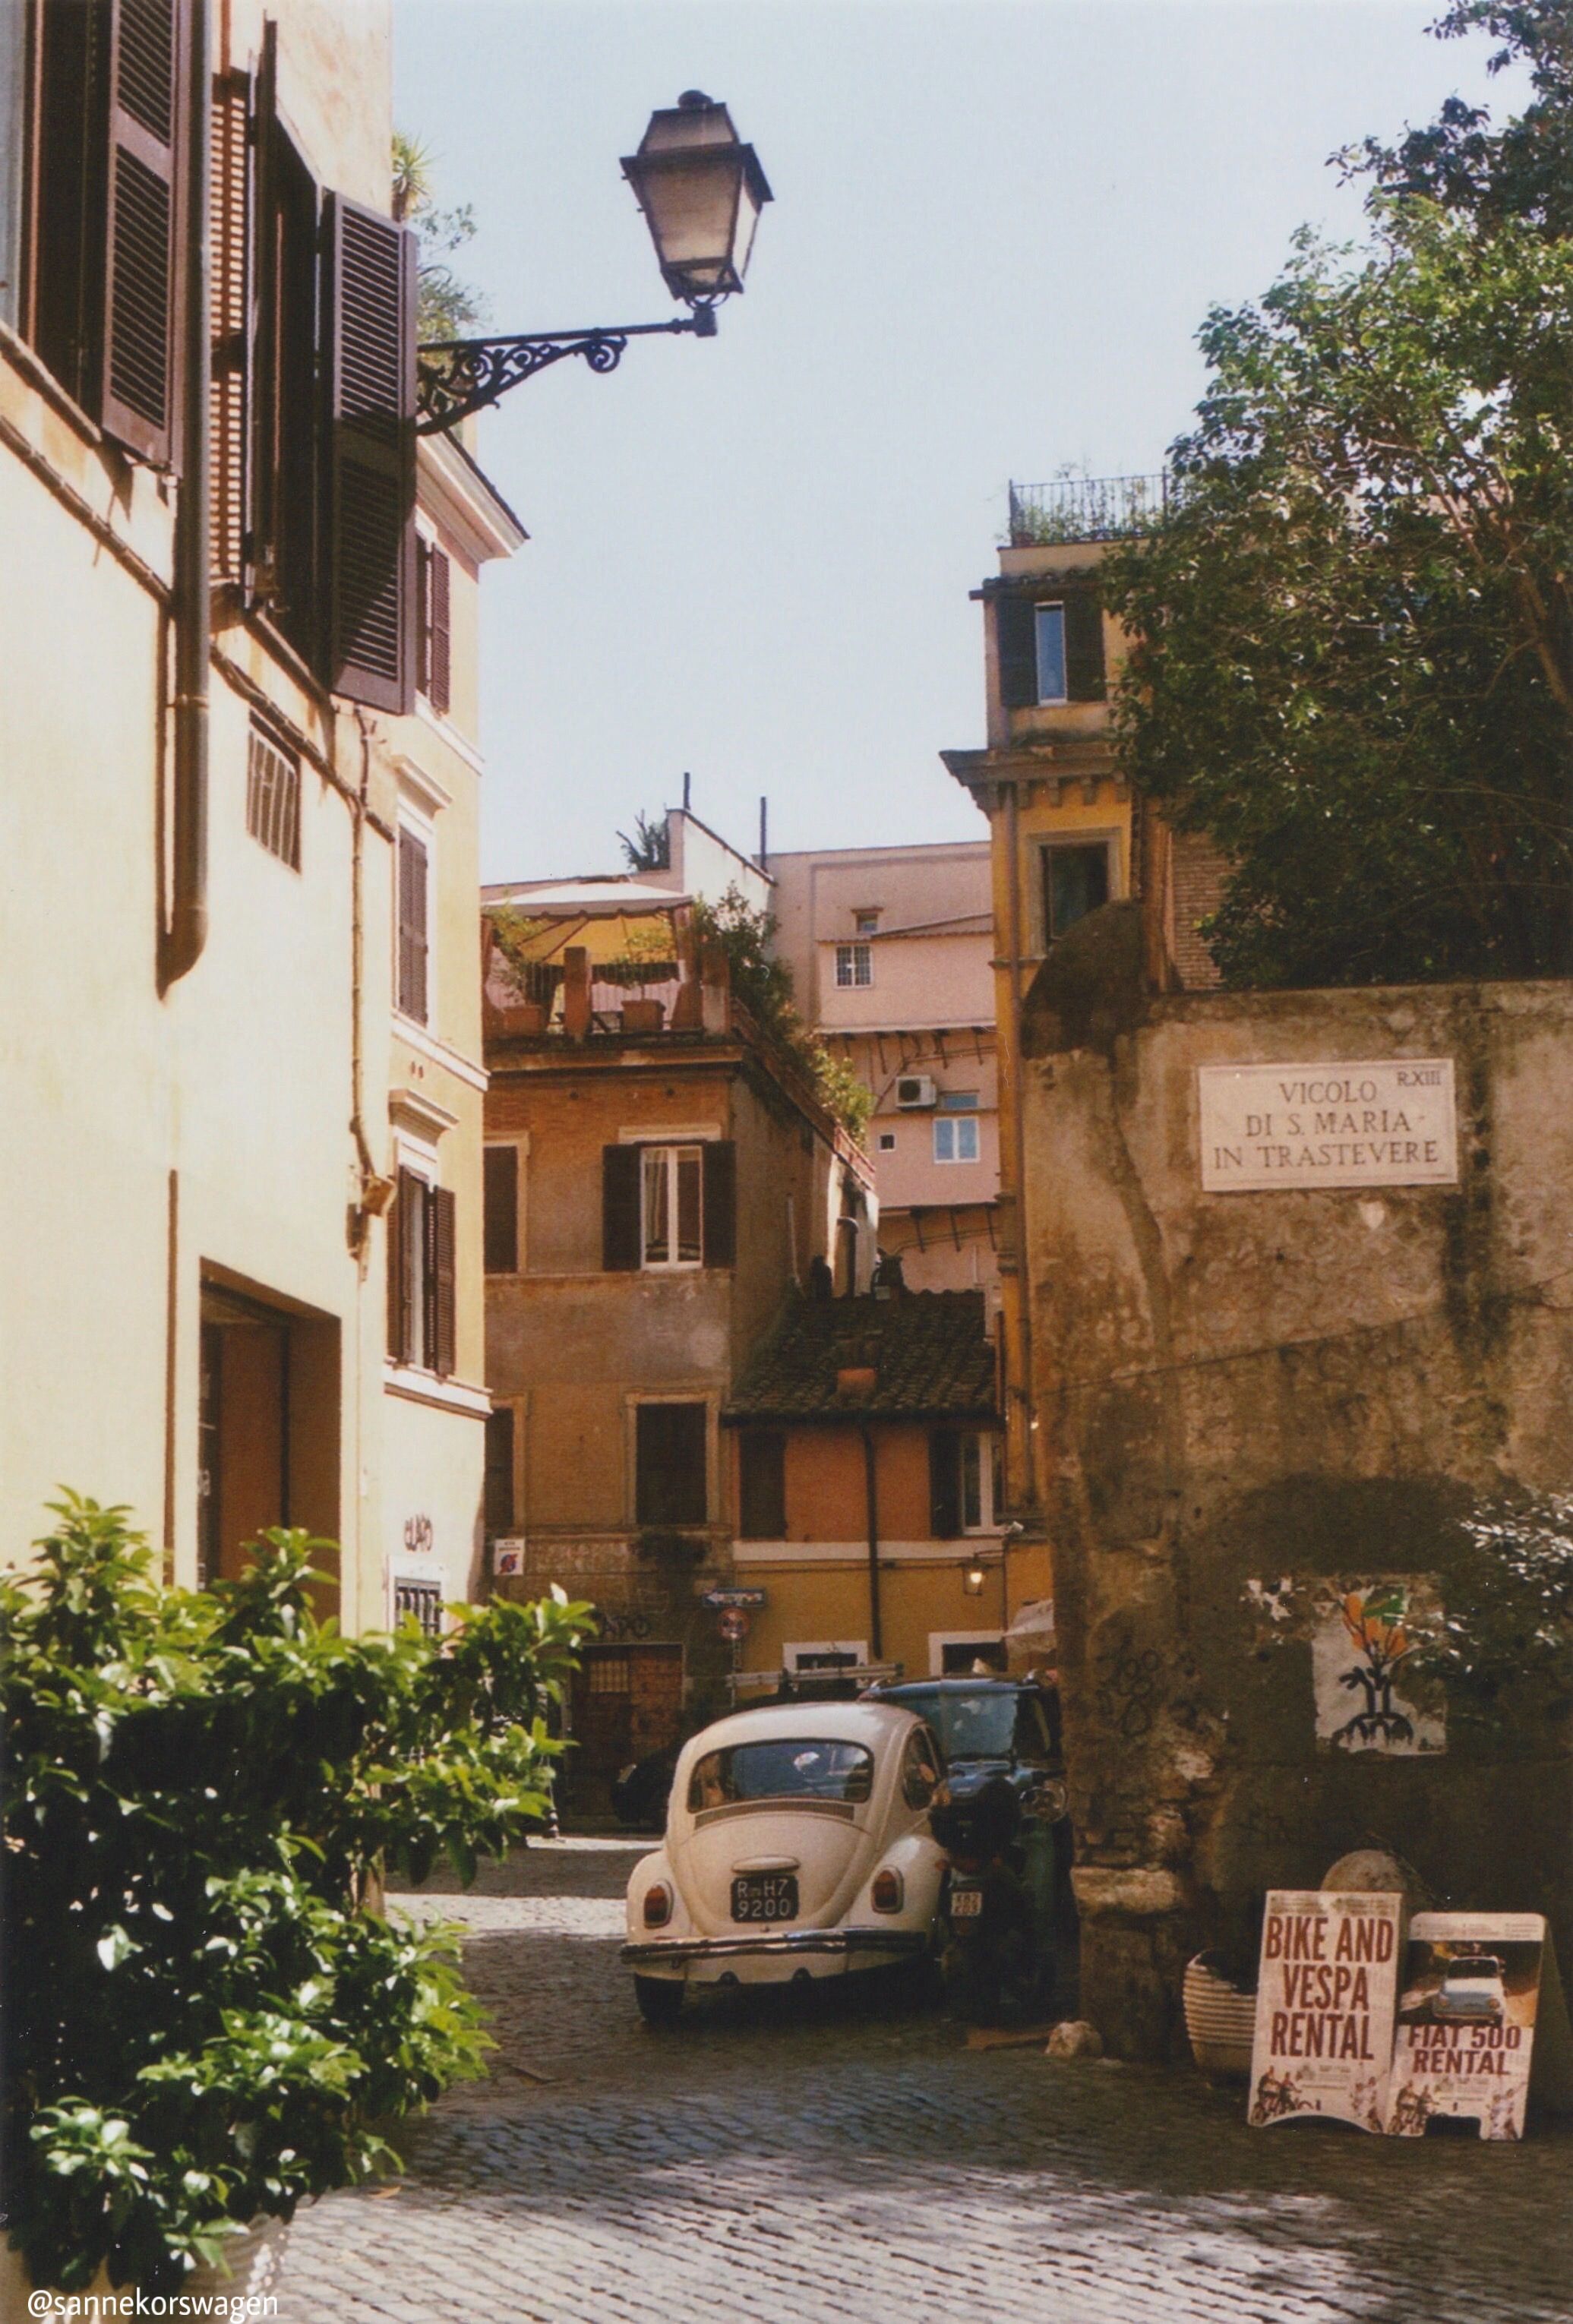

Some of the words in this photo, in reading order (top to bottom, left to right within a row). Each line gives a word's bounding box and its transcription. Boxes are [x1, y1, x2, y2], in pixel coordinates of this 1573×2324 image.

[1279, 1080, 1377, 1104] VICOLO
[1246, 1113, 1271, 1137] DI
[1287, 1112, 1304, 1136] S.
[1315, 1110, 1412, 1134] MARIA
[1214, 1146, 1243, 1170] IN
[1256, 1140, 1439, 1168] TRASTEVERE
[738, 1898, 791, 1918] 9200
[1265, 1915, 1328, 1961] BIKE
[1335, 1917, 1394, 1963] AND
[1283, 1963, 1369, 2012] VESPA
[1270, 2011, 1376, 2061] RENTAL
[1407, 2024, 1463, 2049] FIAT
[1470, 2024, 1522, 2050] 500
[1412, 2049, 1511, 2076] RENTAL
